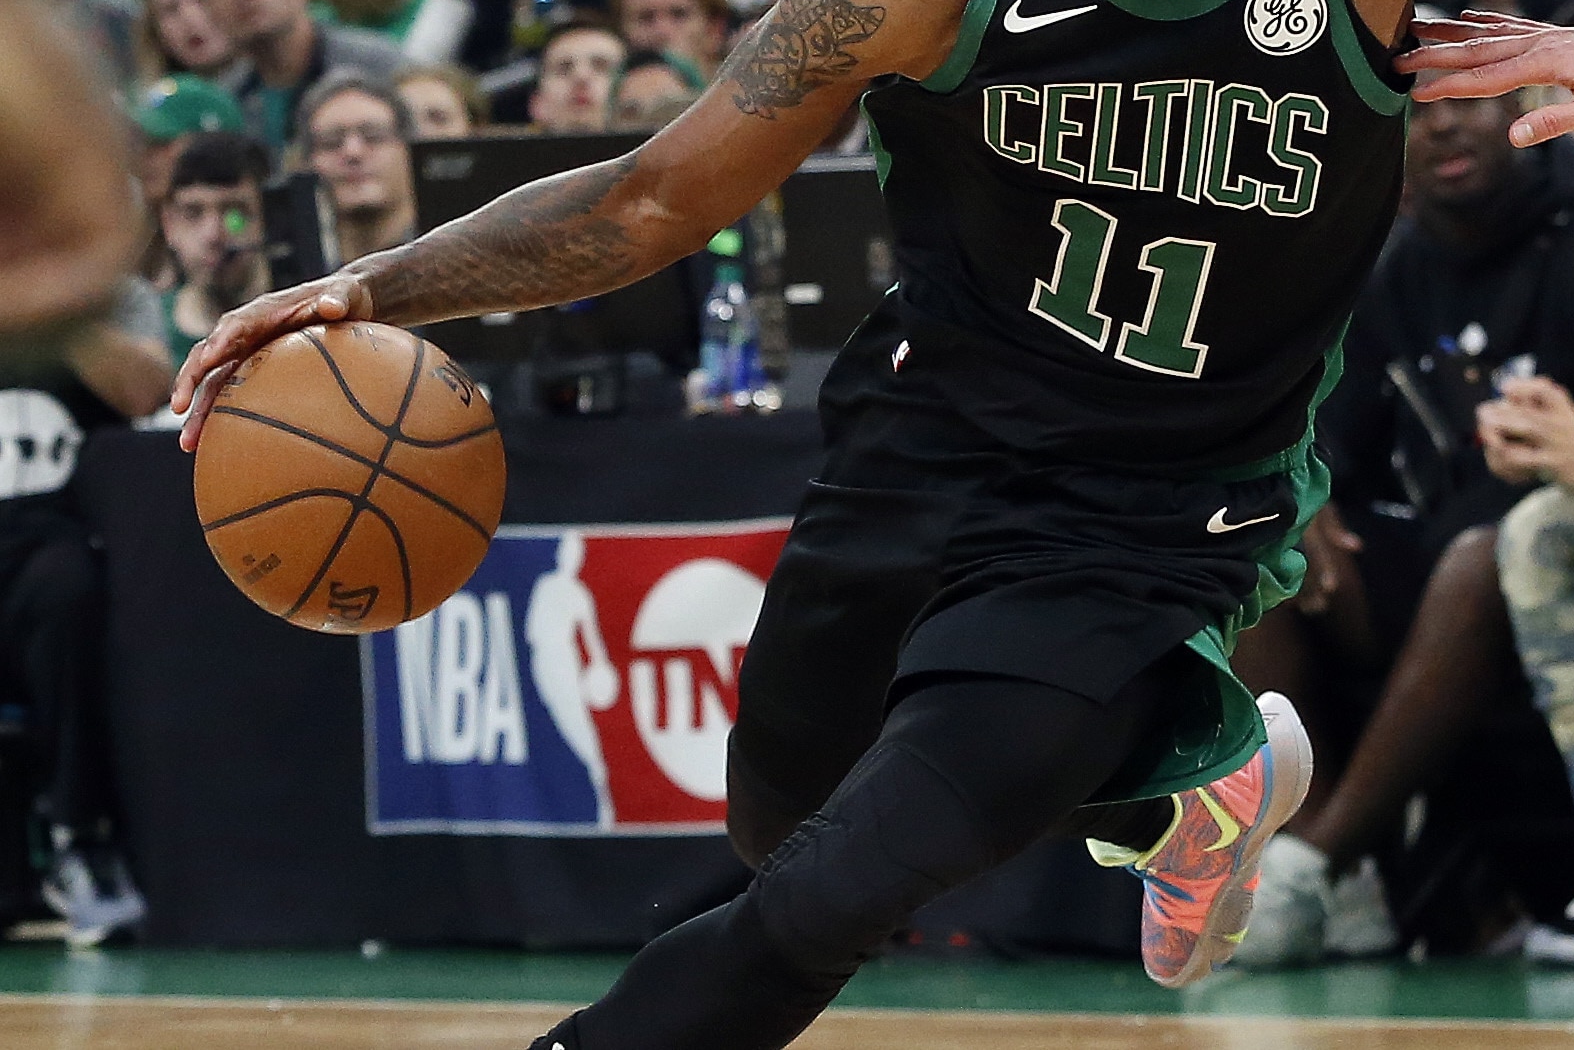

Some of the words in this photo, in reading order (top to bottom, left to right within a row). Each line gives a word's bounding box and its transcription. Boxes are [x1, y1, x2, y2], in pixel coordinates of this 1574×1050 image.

[984, 79, 1330, 218] CELTICS
[1028, 198, 1217, 380] 11
[396, 591, 528, 765] NBA
[628, 645, 748, 732] TN
